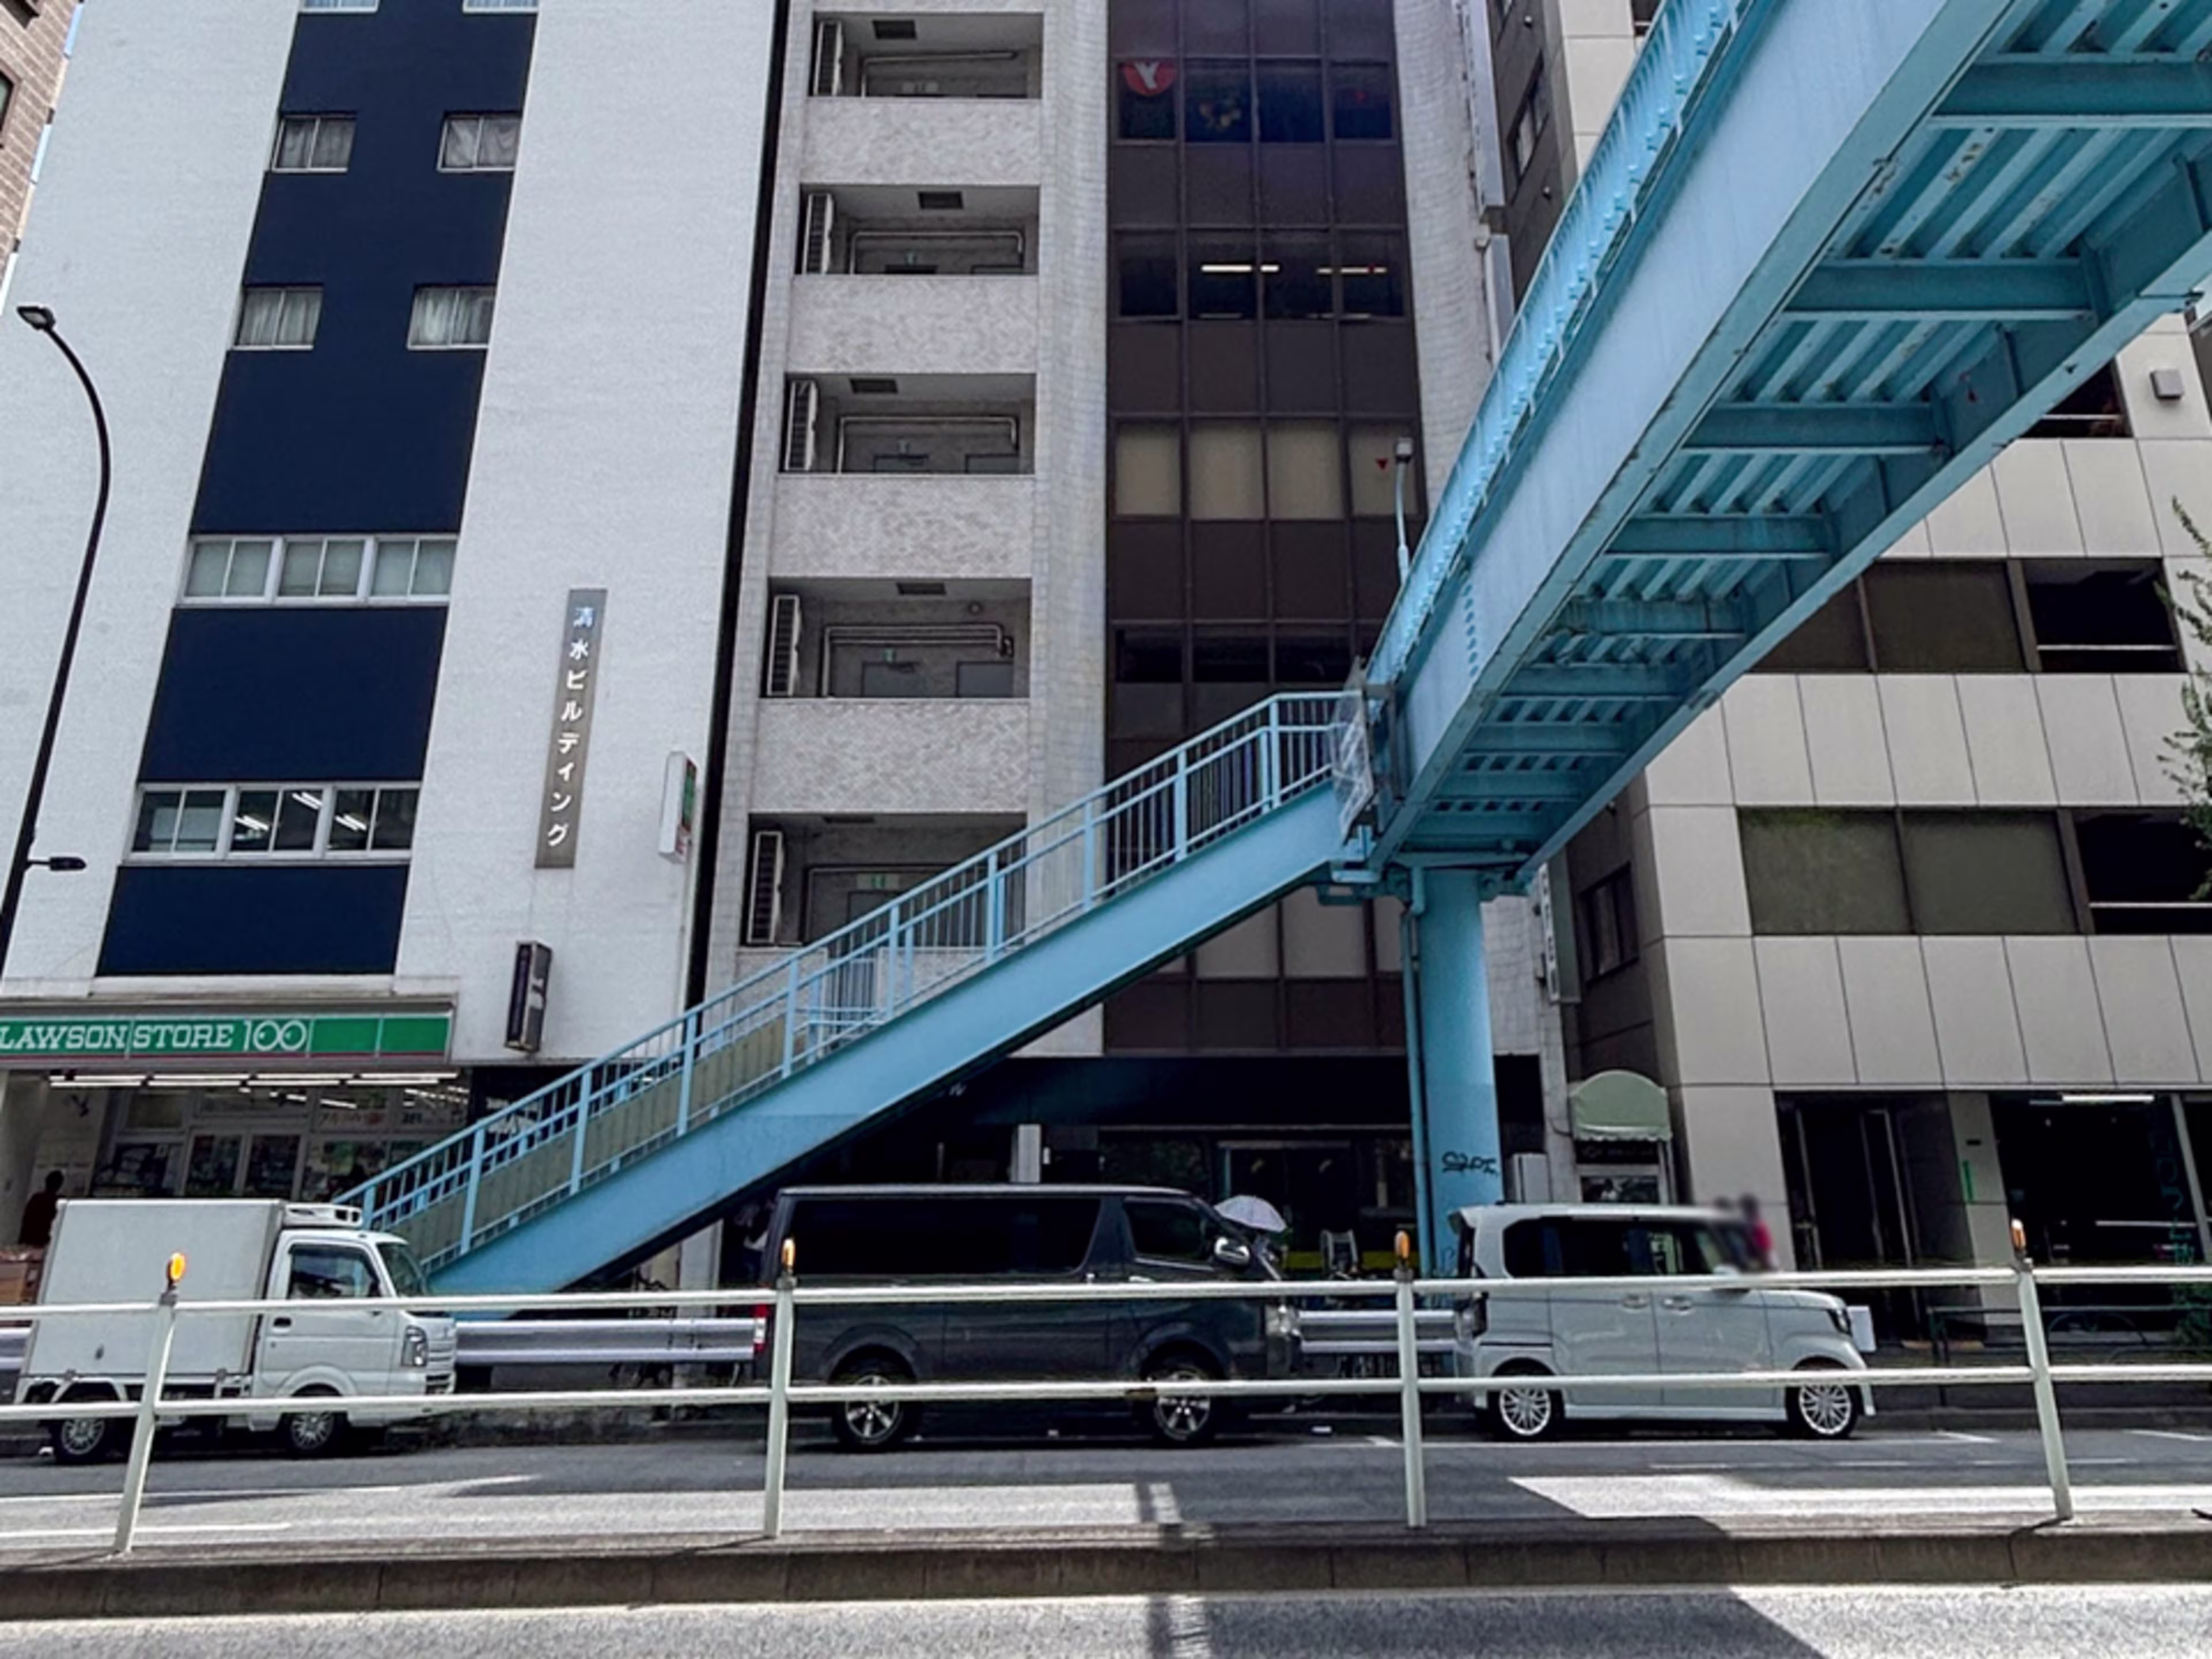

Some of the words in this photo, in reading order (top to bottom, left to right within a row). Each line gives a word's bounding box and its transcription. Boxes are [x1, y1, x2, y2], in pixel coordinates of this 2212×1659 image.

[0, 1025, 128, 1050] LAWSON
[132, 1024, 234, 1049] STORE
[244, 1018, 308, 1052] 100
